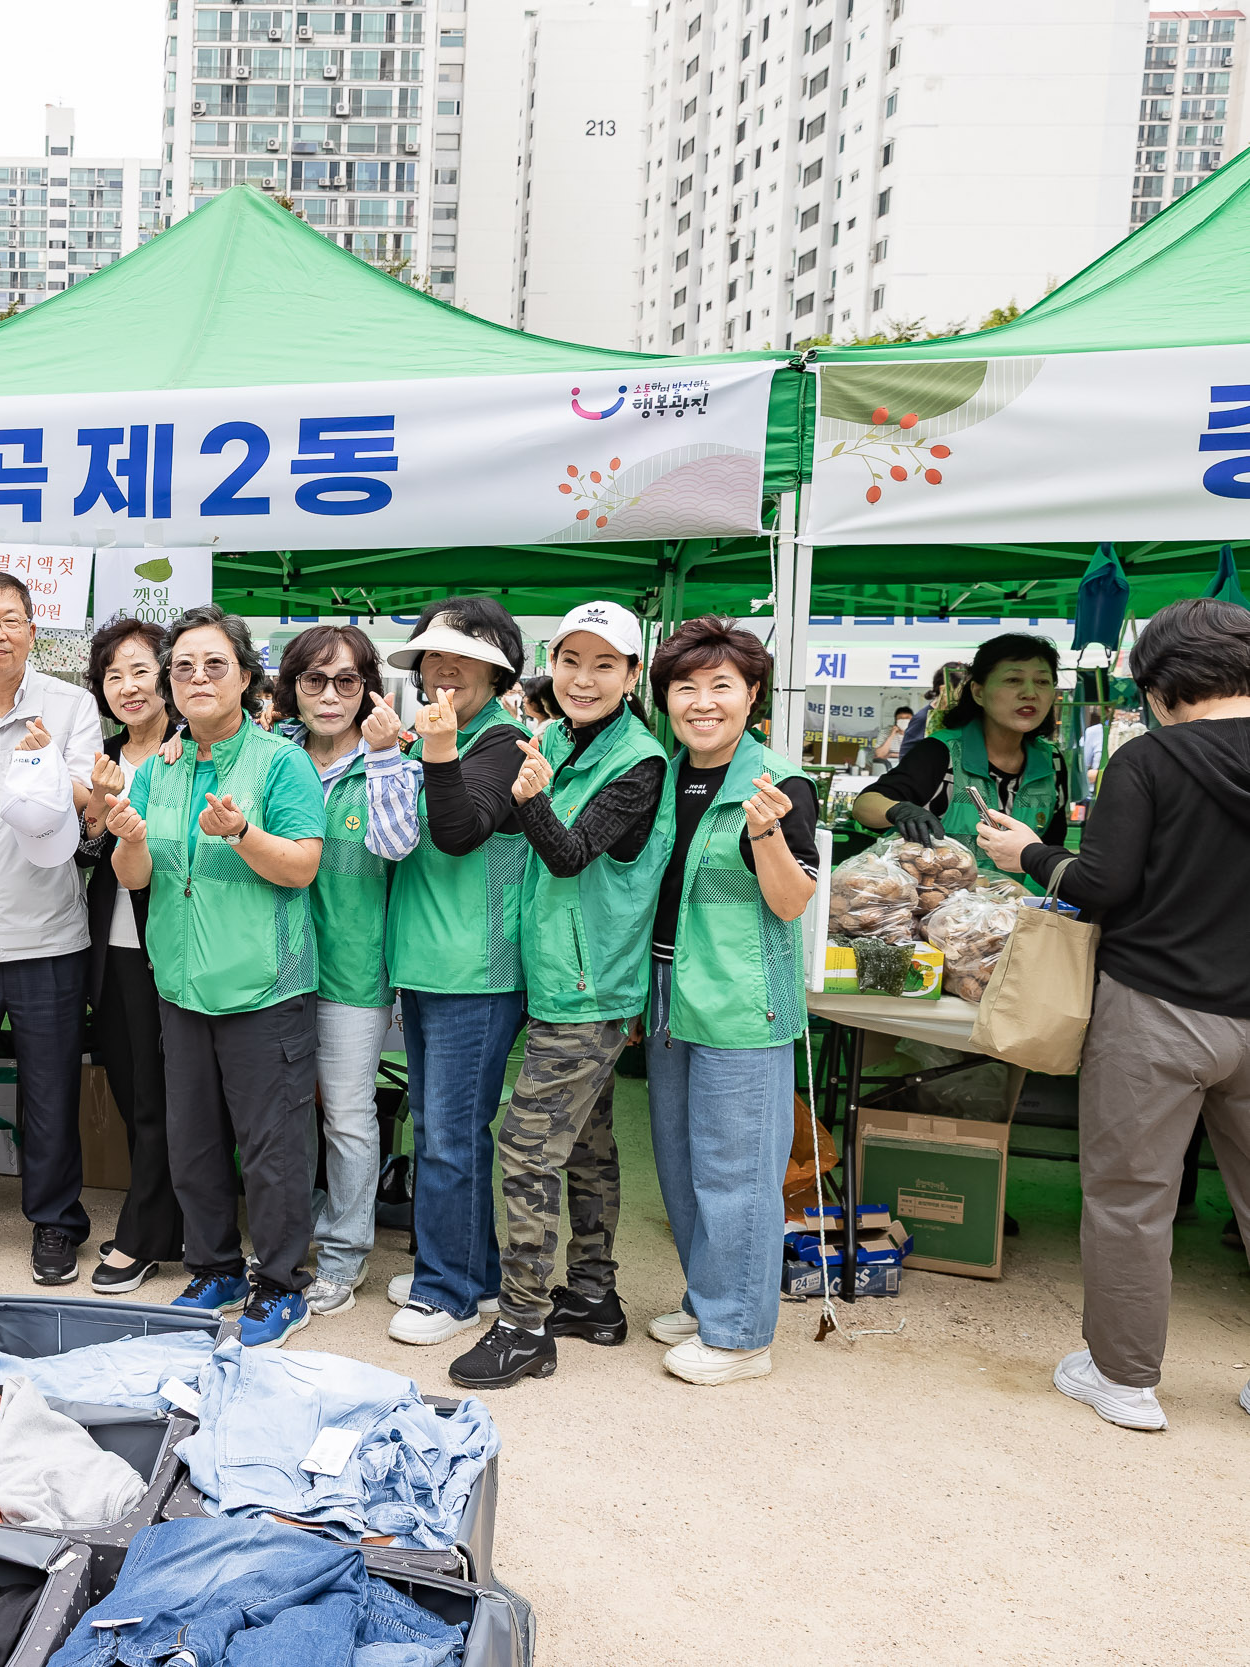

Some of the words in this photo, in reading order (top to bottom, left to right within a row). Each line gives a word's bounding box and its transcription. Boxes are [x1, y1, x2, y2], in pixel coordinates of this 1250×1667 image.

[585, 119, 616, 136] 213
[632, 393, 709, 418] 행복광진
[578, 616, 608, 625] adidas
[889, 654, 920, 679] 군
[795, 1277, 808, 1291] 24
